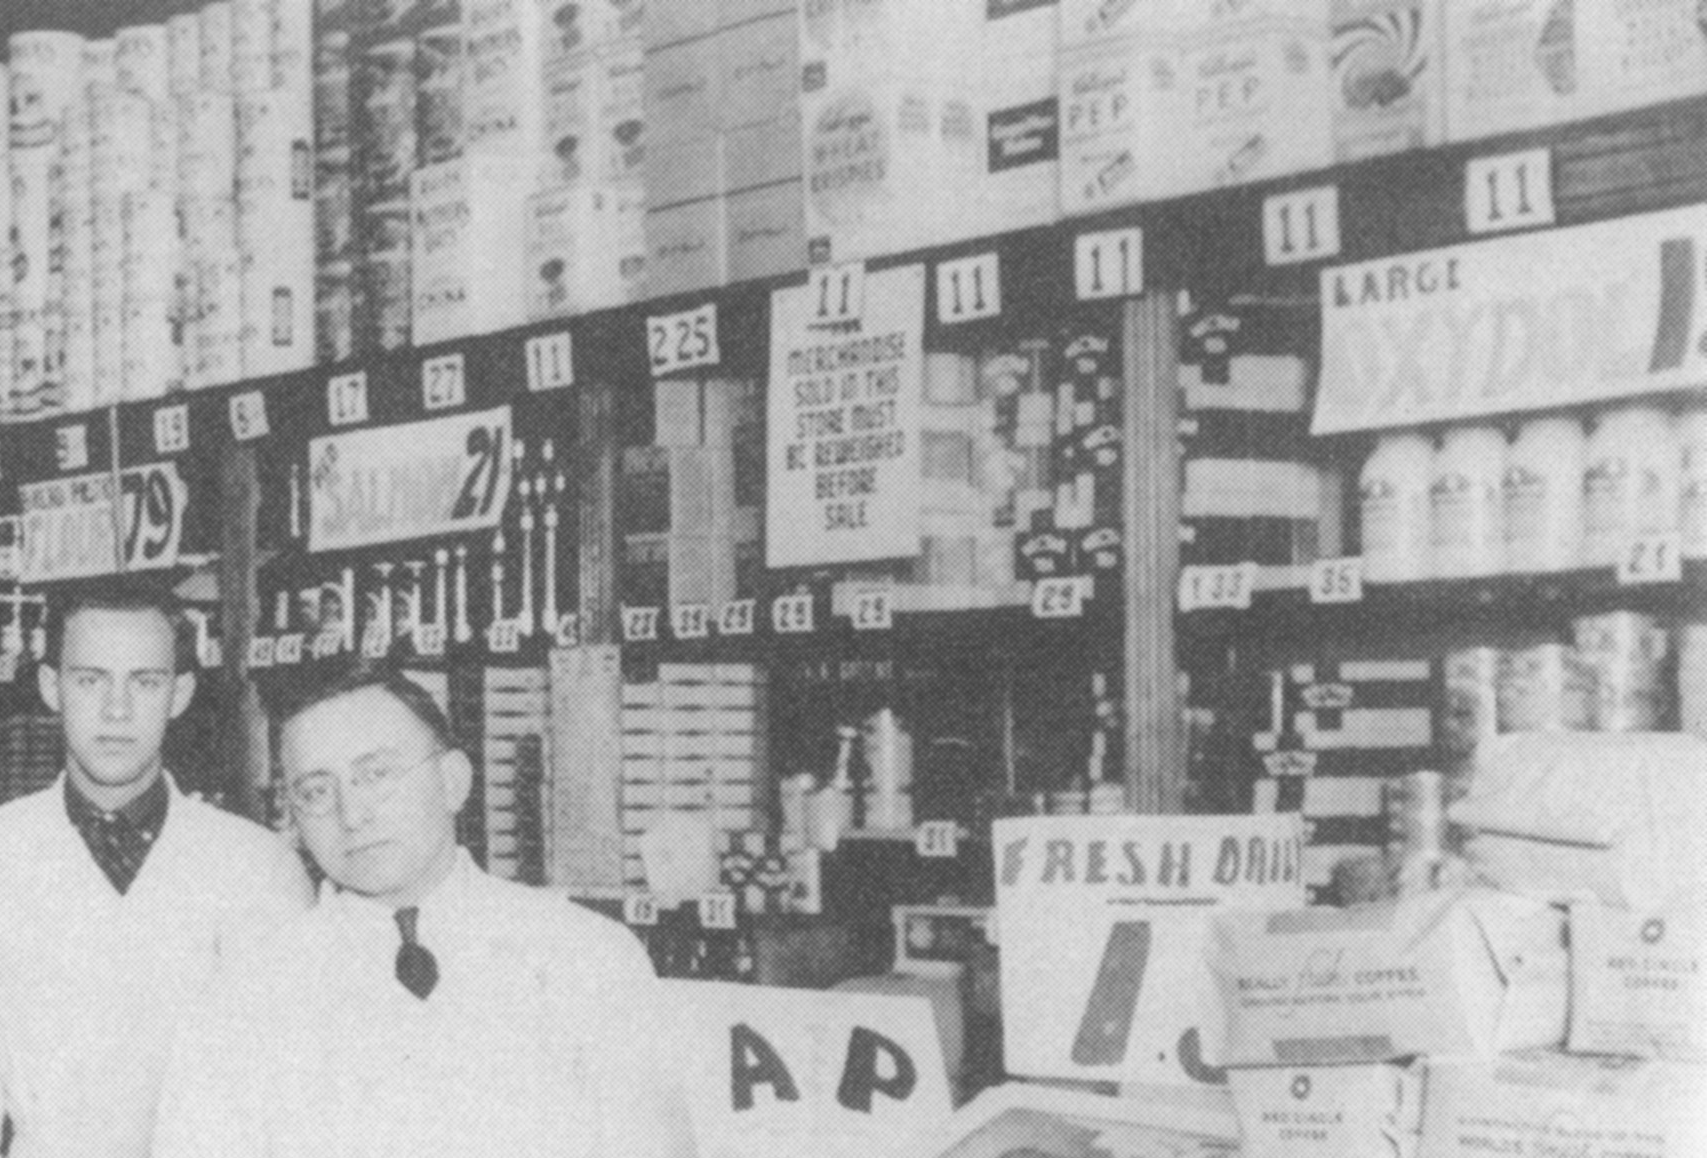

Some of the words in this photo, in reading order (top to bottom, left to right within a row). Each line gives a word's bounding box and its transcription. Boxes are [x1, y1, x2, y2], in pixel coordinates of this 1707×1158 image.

[1485, 163, 1533, 222] 11
[1279, 203, 1320, 253] 11
[1090, 237, 1129, 293] 11
[816, 274, 850, 317] 11
[951, 266, 985, 314] 11
[676, 317, 711, 361] 25
[787, 331, 907, 376] MERCHANDISE
[533, 341, 562, 385] 11
[794, 379, 835, 408] SOLD
[864, 365, 900, 396] THIS
[795, 407, 846, 439] STORE
[850, 399, 897, 430] MUST
[449, 425, 504, 520] 21
[815, 466, 878, 500] BEFORE
[824, 501, 869, 531] SALE
[1000, 837, 1191, 887] FRESH
